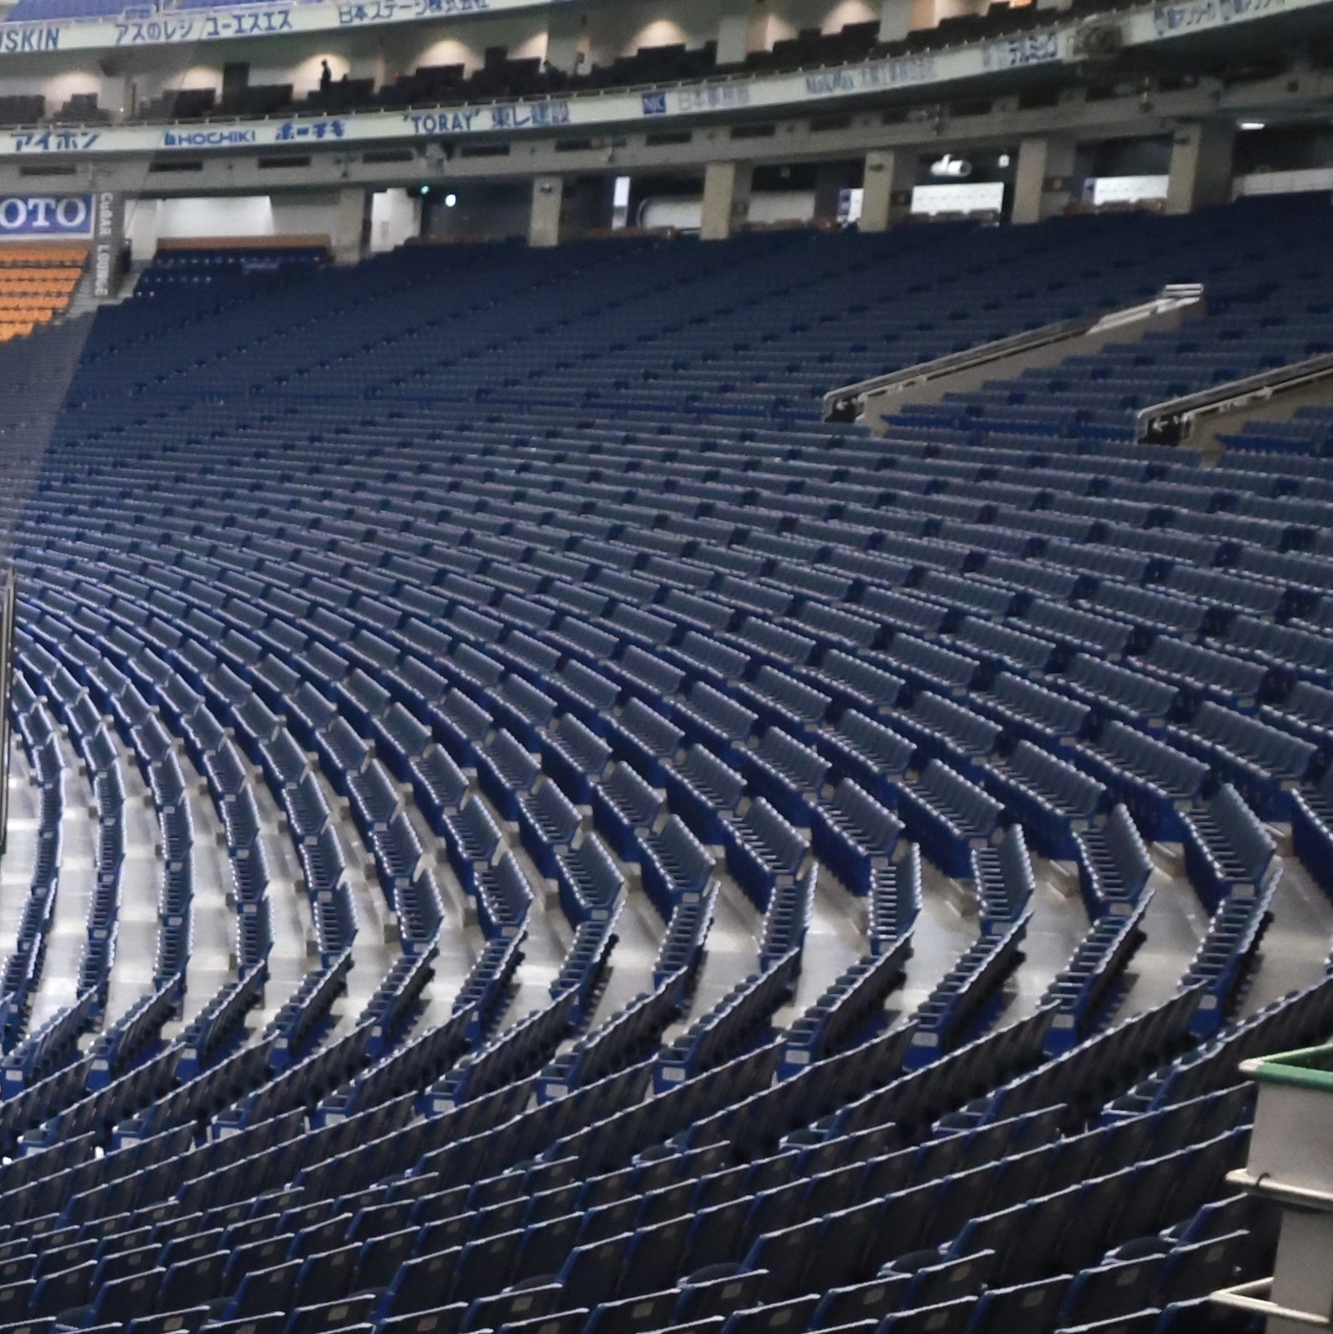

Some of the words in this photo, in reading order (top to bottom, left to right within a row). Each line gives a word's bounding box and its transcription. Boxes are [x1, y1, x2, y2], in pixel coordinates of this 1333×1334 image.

[206, 11, 293, 36] ユーエスエス
[11, 131, 102, 152] アイホン
